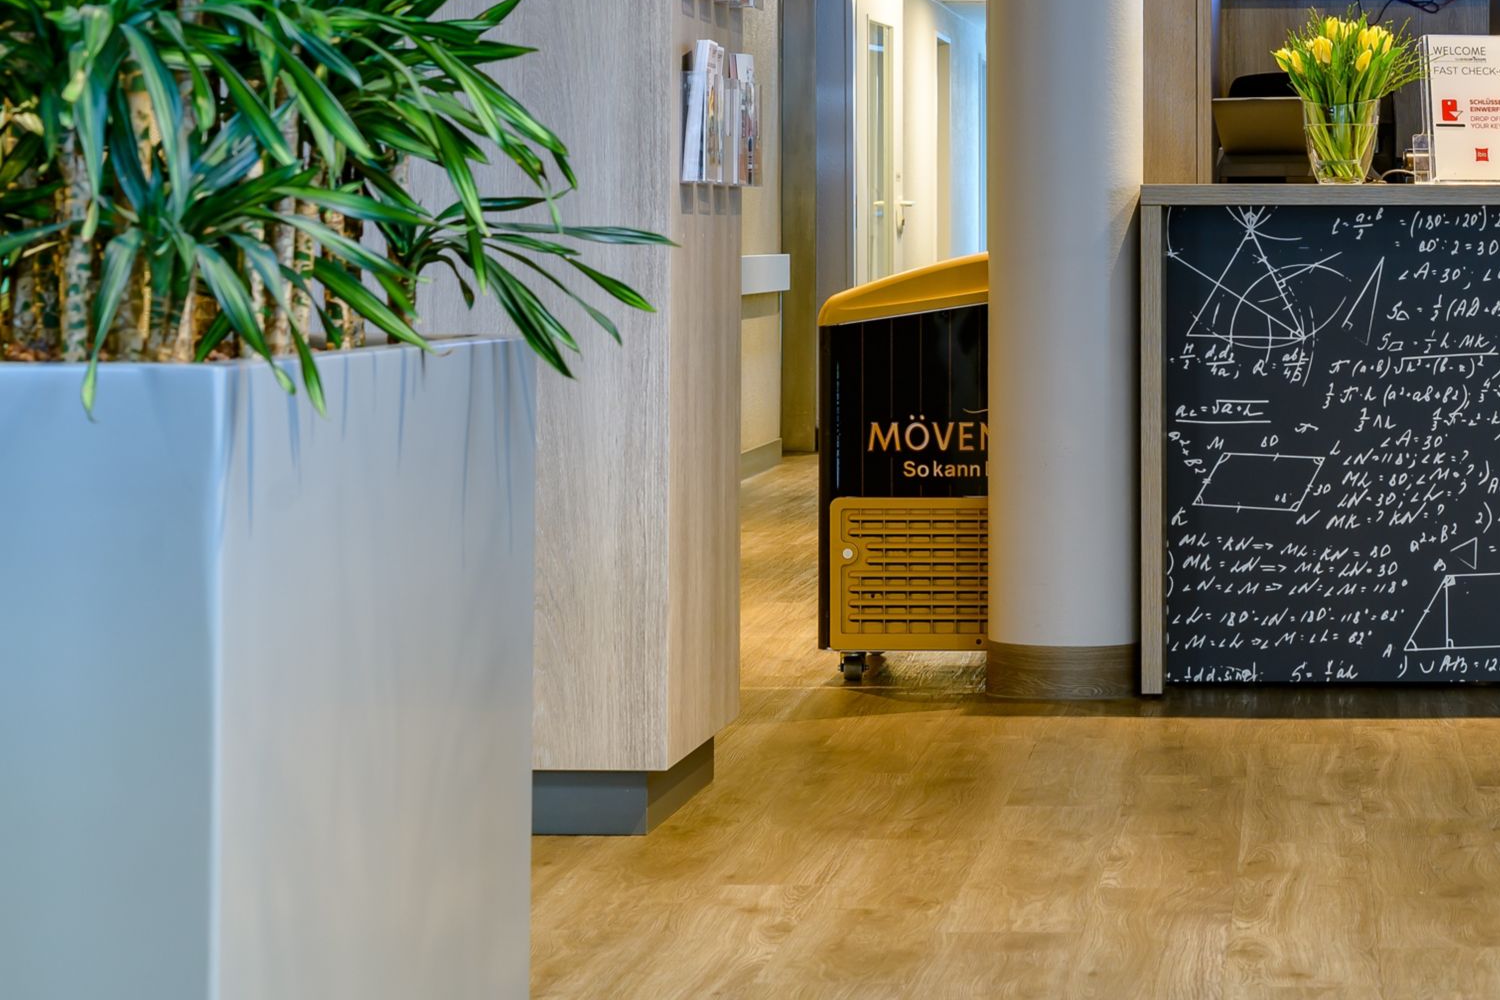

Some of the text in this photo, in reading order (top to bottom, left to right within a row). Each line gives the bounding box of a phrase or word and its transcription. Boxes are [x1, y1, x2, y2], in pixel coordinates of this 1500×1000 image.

[1433, 46, 1486, 56] WELCOME
[1433, 66, 1458, 75] FAST
[903, 460, 930, 478] So
[933, 459, 981, 478] kann
